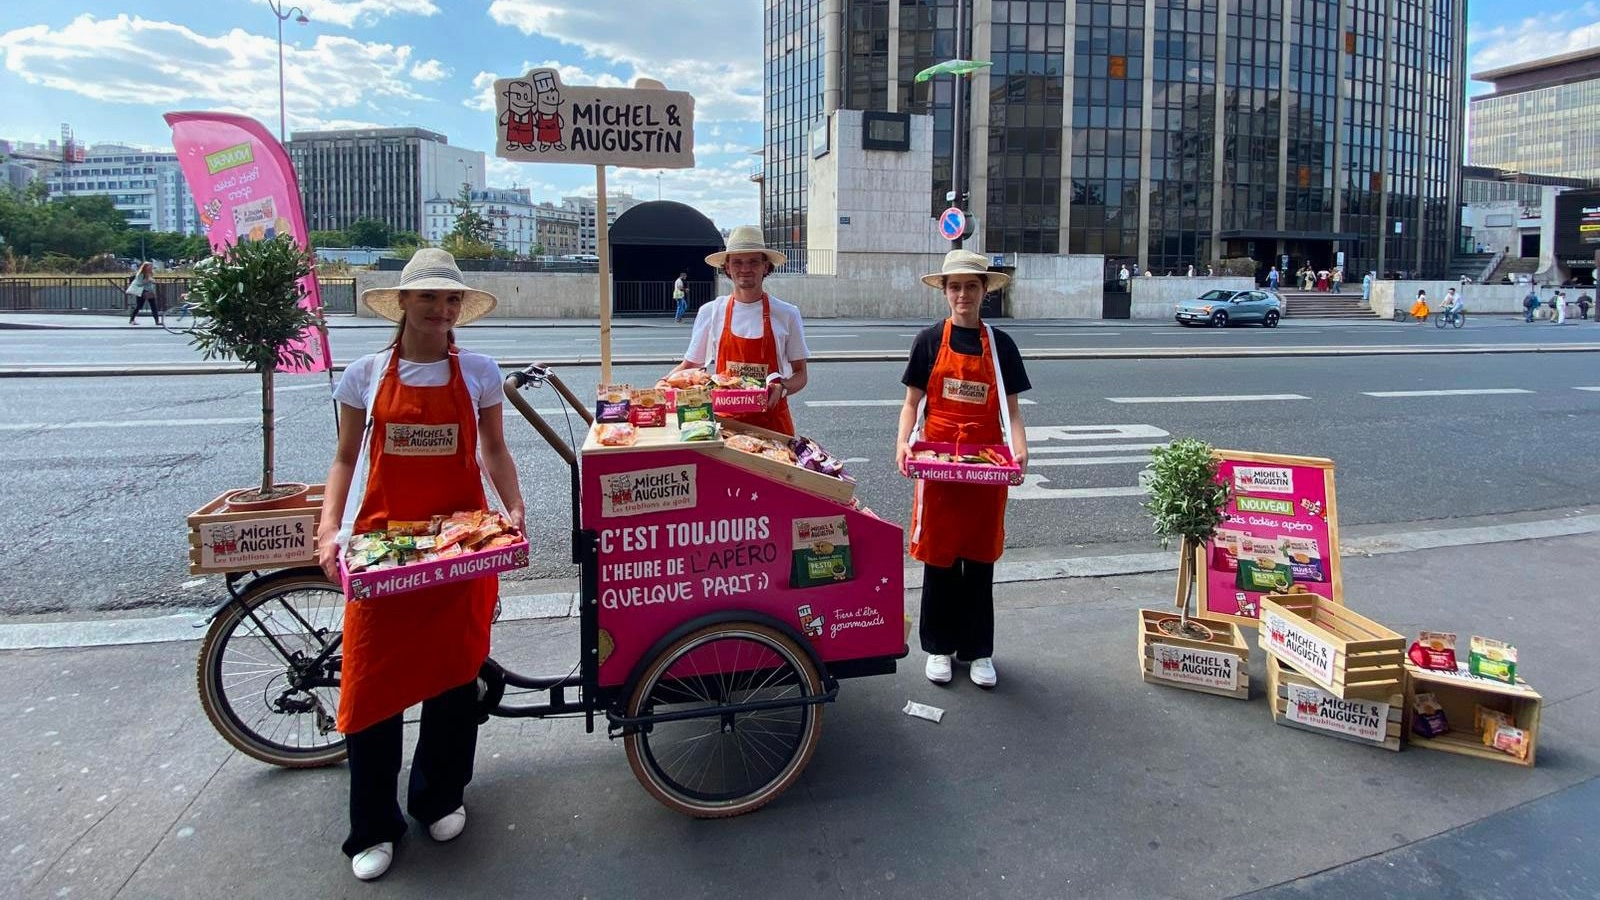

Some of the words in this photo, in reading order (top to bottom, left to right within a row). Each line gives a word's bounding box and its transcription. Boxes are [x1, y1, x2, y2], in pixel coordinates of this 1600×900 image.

[666, 104, 681, 127] &
[1240, 498, 1290, 512] NOUVEAU
[1249, 516, 1279, 527] Cookies
[601, 525, 659, 554] C'EST
[666, 516, 770, 548] TOUJOURS
[602, 559, 662, 582] L'HEURE
[667, 558, 684, 575] DE
[690, 542, 777, 574] L'APÉRO
[435, 568, 444, 580] &
[602, 581, 693, 609] QUELQUE
